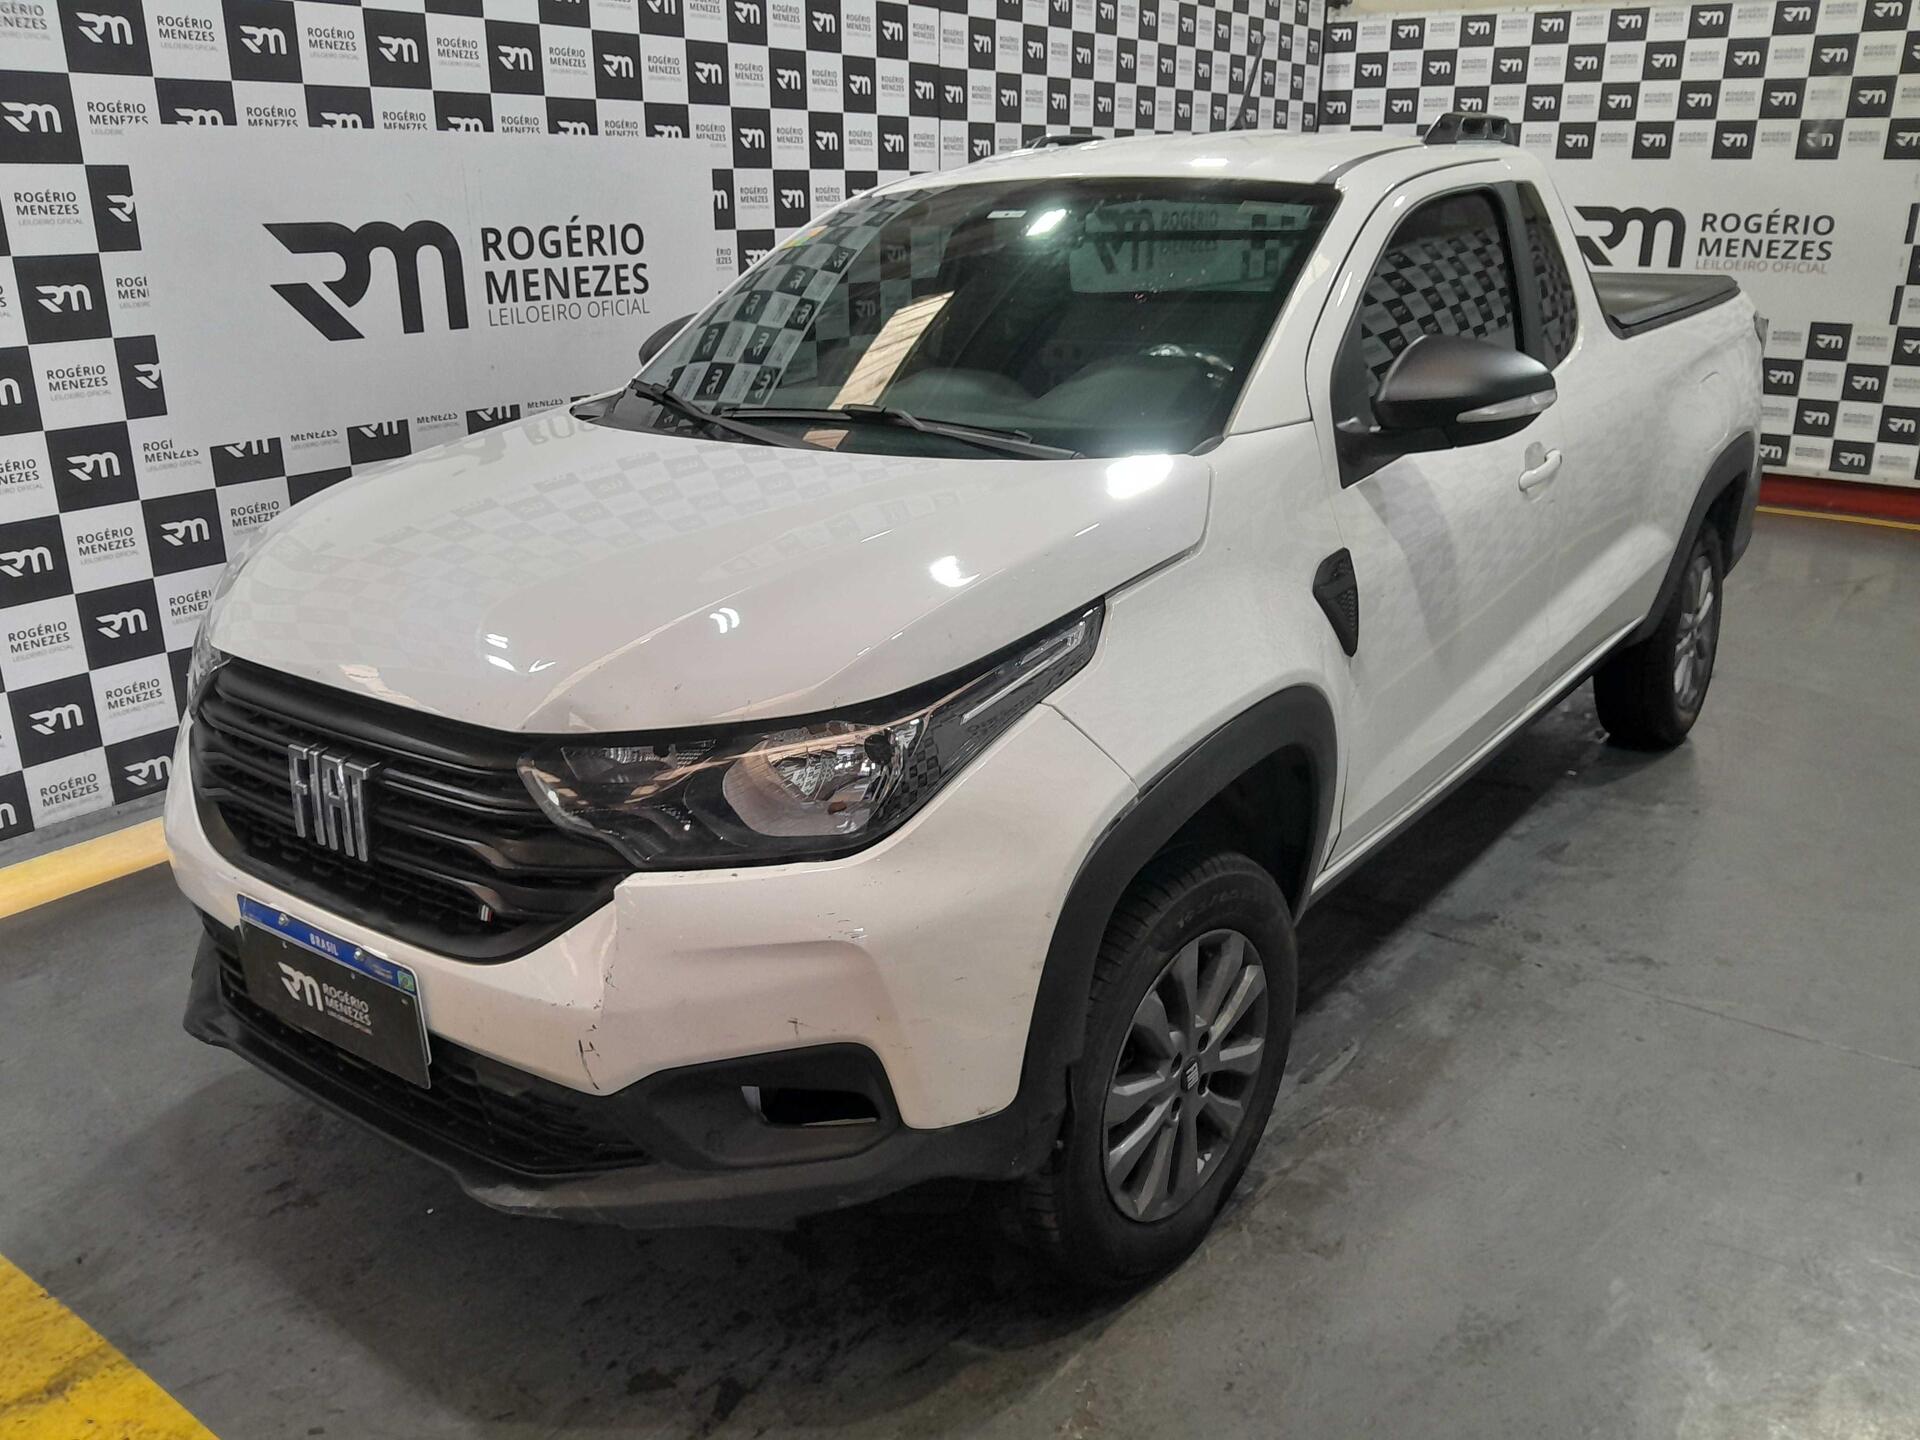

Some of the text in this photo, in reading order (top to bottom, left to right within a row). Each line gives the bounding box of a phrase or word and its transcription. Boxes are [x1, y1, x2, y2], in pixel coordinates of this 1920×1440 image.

[156, 15, 213, 30] ROGÉRIO
[158, 27, 216, 42] MENEZES
[307, 27, 356, 41] ROGÉRIO
[308, 38, 358, 52] MENEZES
[436, 37, 479, 50] ROGÉRIO
[437, 48, 480, 61] MENEZES
[549, 46, 586, 59] ROGÉRIO
[647, 55, 680, 66] ROGÉRIO
[549, 56, 587, 68] MENEZES
[648, 64, 681, 75] MENEZES
[86, 99, 147, 114] ROGÉRIO
[246, 105, 298, 119] ROGÉRIO
[382, 110, 427, 123] ROGÉRIO
[501, 115, 540, 126] ROGÉRIO
[604, 119, 638, 130] ROGÉRIO
[13, 189, 77, 203] ROGÉRIO
[15, 203, 80, 216] MENEZES
[1701, 209, 1835, 236] ROGÉRIO
[481, 215, 645, 261] ROGÉRIO
[1698, 237, 1832, 261] MENEZES
[485, 263, 650, 304] MENEZES
[489, 298, 650, 326] LEILOEIRO OFICIAL
[45, 364, 107, 380] ROGÉRIO
[48, 375, 110, 392] MENEZES
[230, 500, 281, 518] ROGÉRIO
[76, 526, 135, 546] ROGÉRIO
[78, 536, 137, 557] MENEZES
[8, 621, 68, 642] ROGÉRIO
[10, 632, 71, 653] MENEZES
[105, 678, 160, 700] ROGÉRIO
[107, 688, 163, 710] MENEZES
[39, 772, 97, 797] ROGÉRIO
[42, 781, 100, 807] MENEZES
[288, 744, 368, 862] FIAT
[309, 933, 338, 956] BRASIL
[322, 982, 369, 1014] ROGÉRIO
[324, 994, 372, 1028] MENEZES
